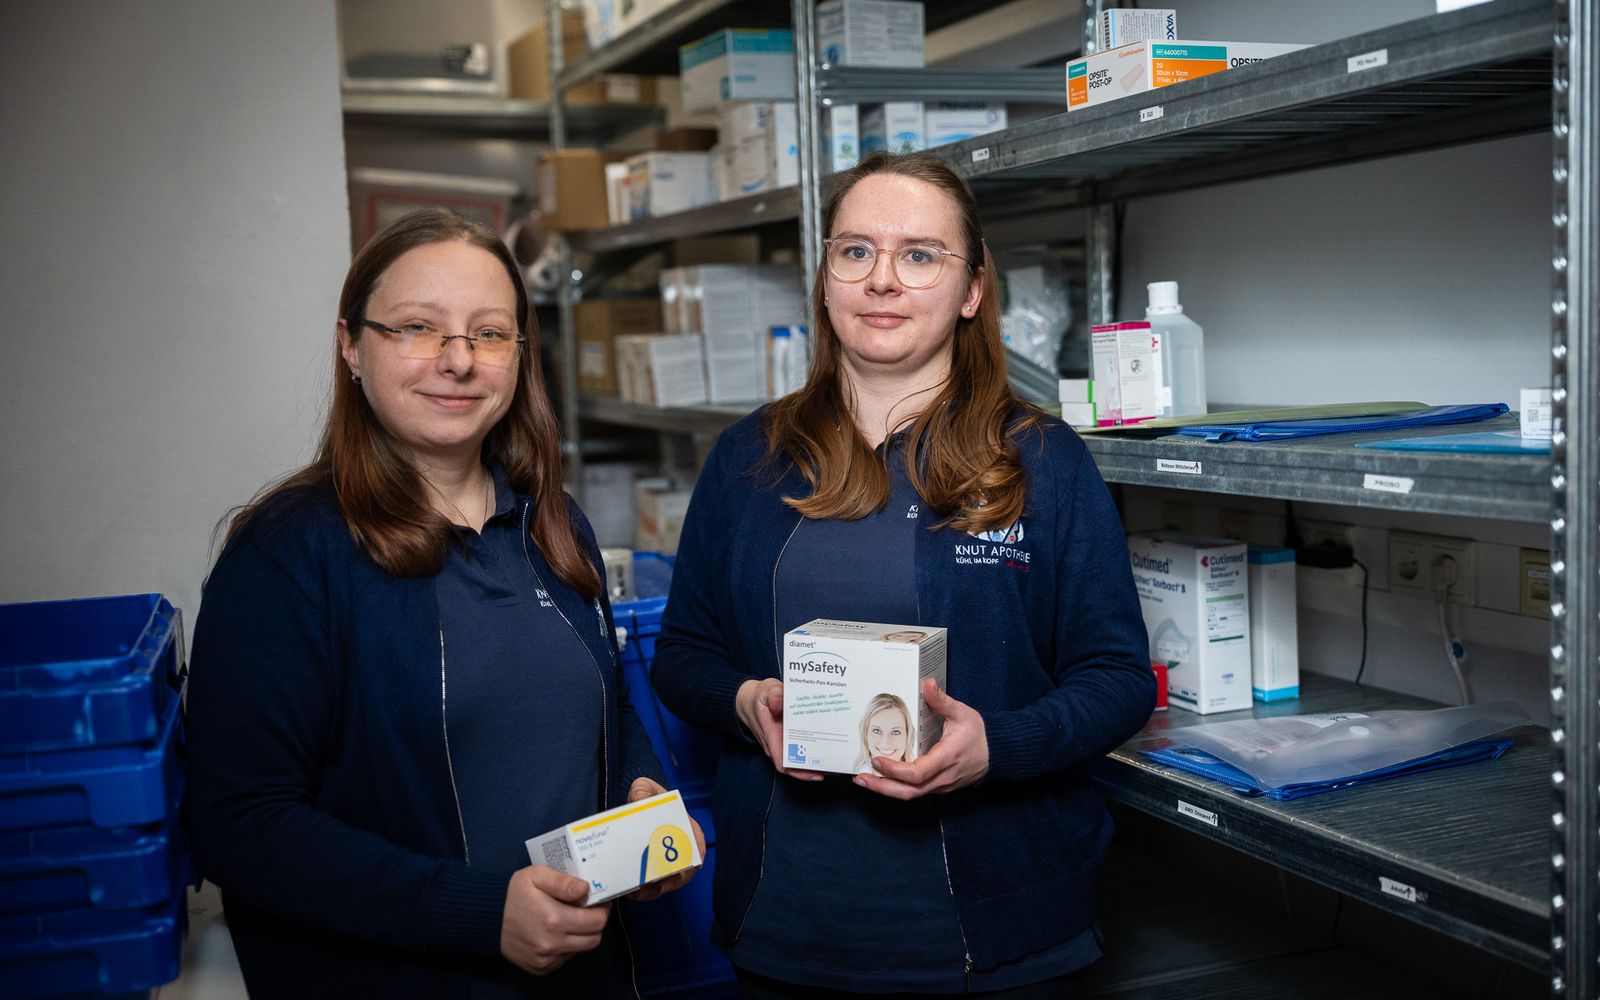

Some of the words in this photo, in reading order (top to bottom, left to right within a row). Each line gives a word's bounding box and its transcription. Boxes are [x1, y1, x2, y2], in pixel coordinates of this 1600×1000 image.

[1088, 69, 1108, 80] OPSITE
[1088, 77, 1112, 89] POST-OP
[955, 544, 986, 556] KNUT
[983, 556, 1000, 565] KOPF
[1132, 552, 1169, 574] Cutimed
[1210, 553, 1244, 565] Cutimed
[789, 640, 814, 649] diamet
[789, 660, 847, 677] mySafety
[789, 677, 847, 687] Sicherheits-Pen-Kanülen
[797, 744, 806, 757] 8
[662, 835, 679, 863] 8
